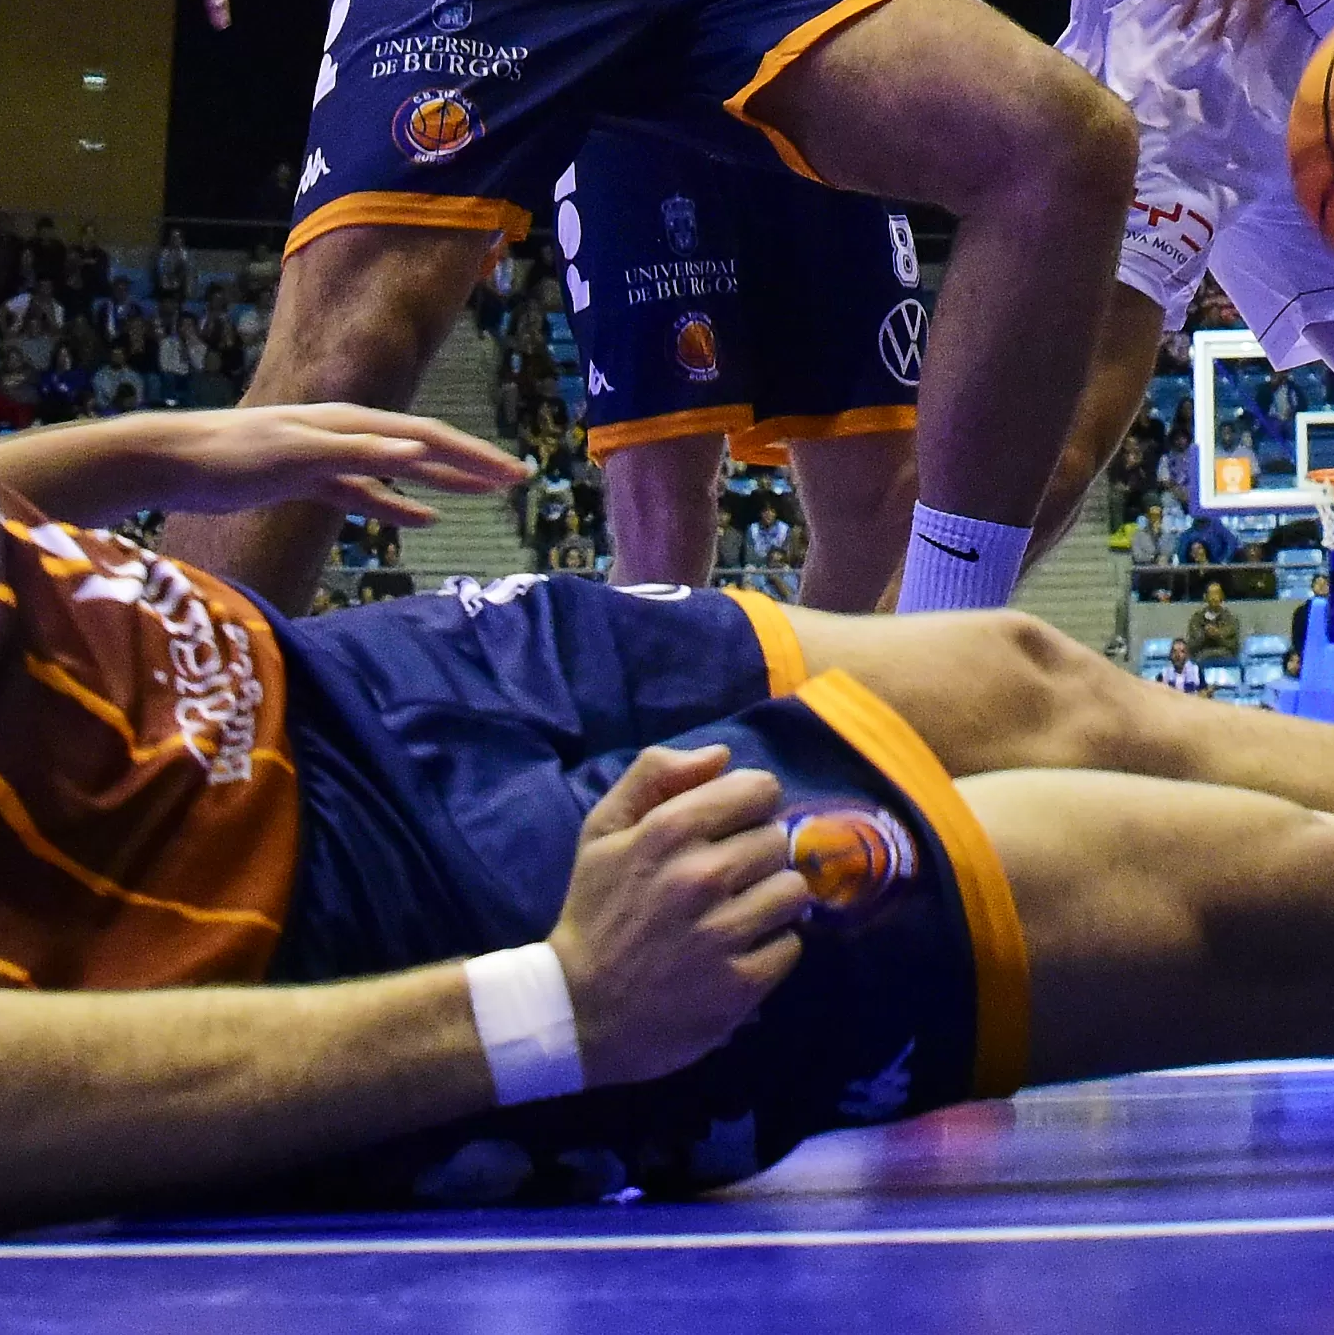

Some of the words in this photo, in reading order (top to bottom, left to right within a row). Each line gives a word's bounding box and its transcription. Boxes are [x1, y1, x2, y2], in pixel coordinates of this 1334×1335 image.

[375, 35, 529, 61] UNIVERSIDAD
[371, 58, 399, 79] DE
[403, 52, 523, 81] BURGOS
[628, 287, 652, 305] DE
